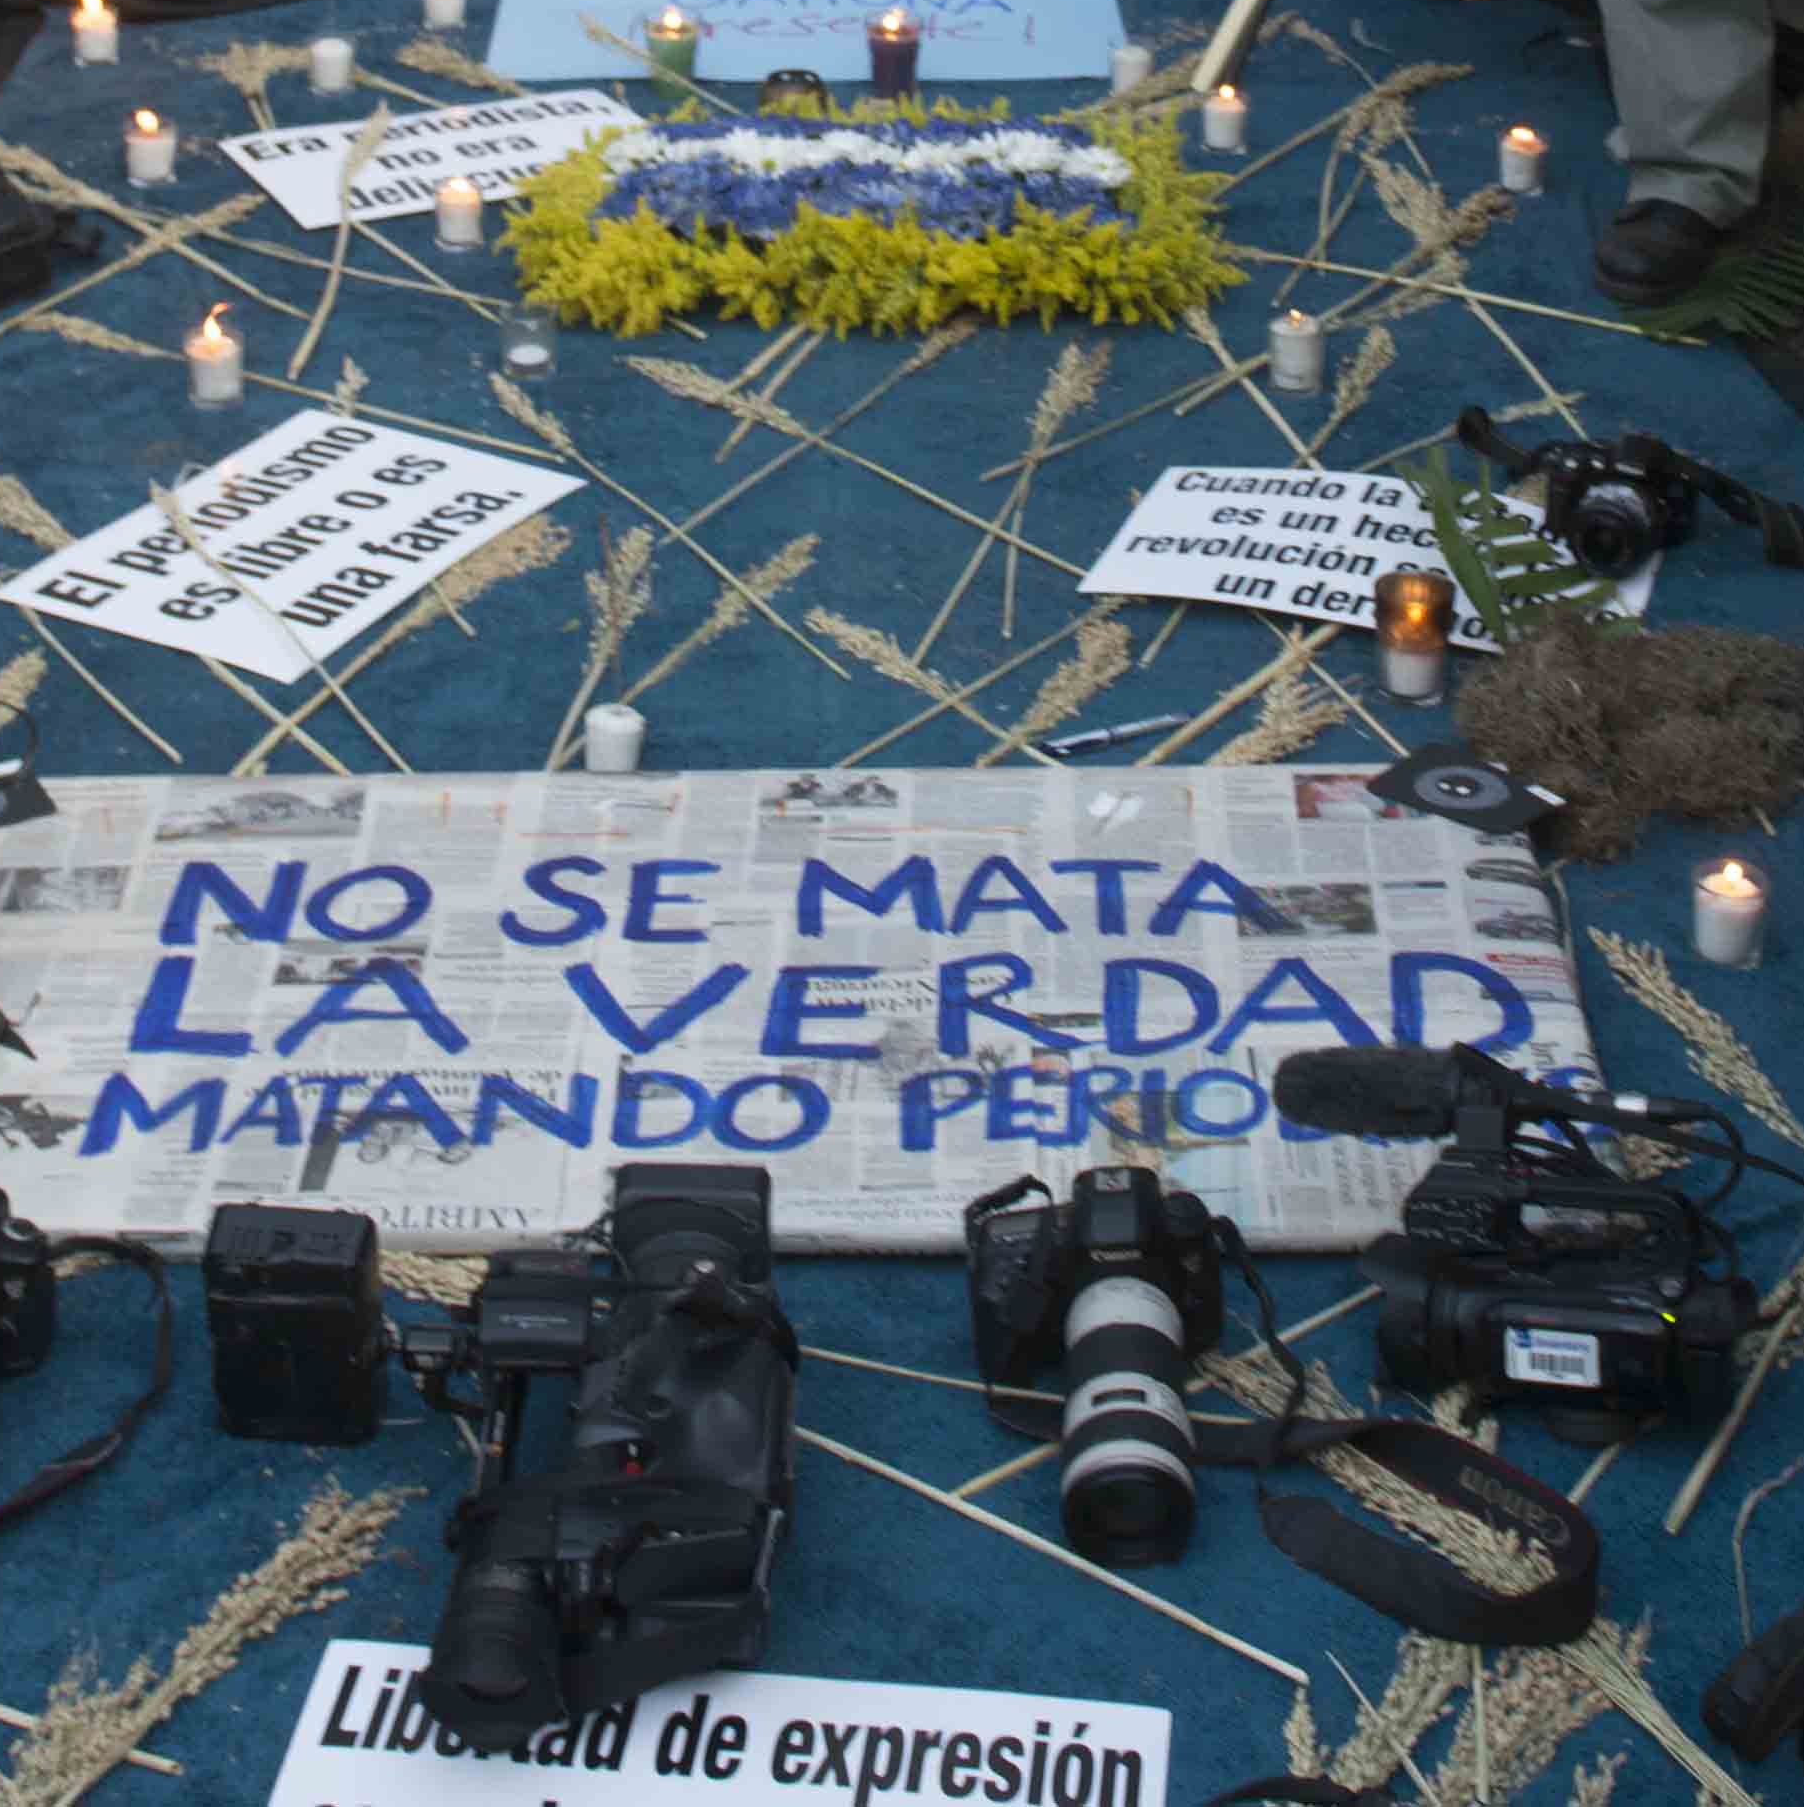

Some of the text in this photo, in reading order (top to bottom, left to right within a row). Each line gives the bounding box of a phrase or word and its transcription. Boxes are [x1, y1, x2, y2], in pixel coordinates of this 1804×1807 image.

[242, 132, 328, 161] Era
[373, 132, 539, 173] no era
[35, 424, 377, 610] El peiodismo
[1174, 469, 1403, 508] Cuando la
[1209, 503, 1438, 550] es un hec
[159, 452, 448, 622] es libre o es
[278, 488, 526, 628] una farsa.
[1124, 533, 1378, 579] revolución
[1213, 573, 1276, 601] un
[158, 853, 1307, 949] NO SE MATA
[128, 949, 1536, 1060] LA VERDAD
[78, 1070, 832, 1158] MATANDO
[320, 1664, 1145, 1807] Libad de expresión
